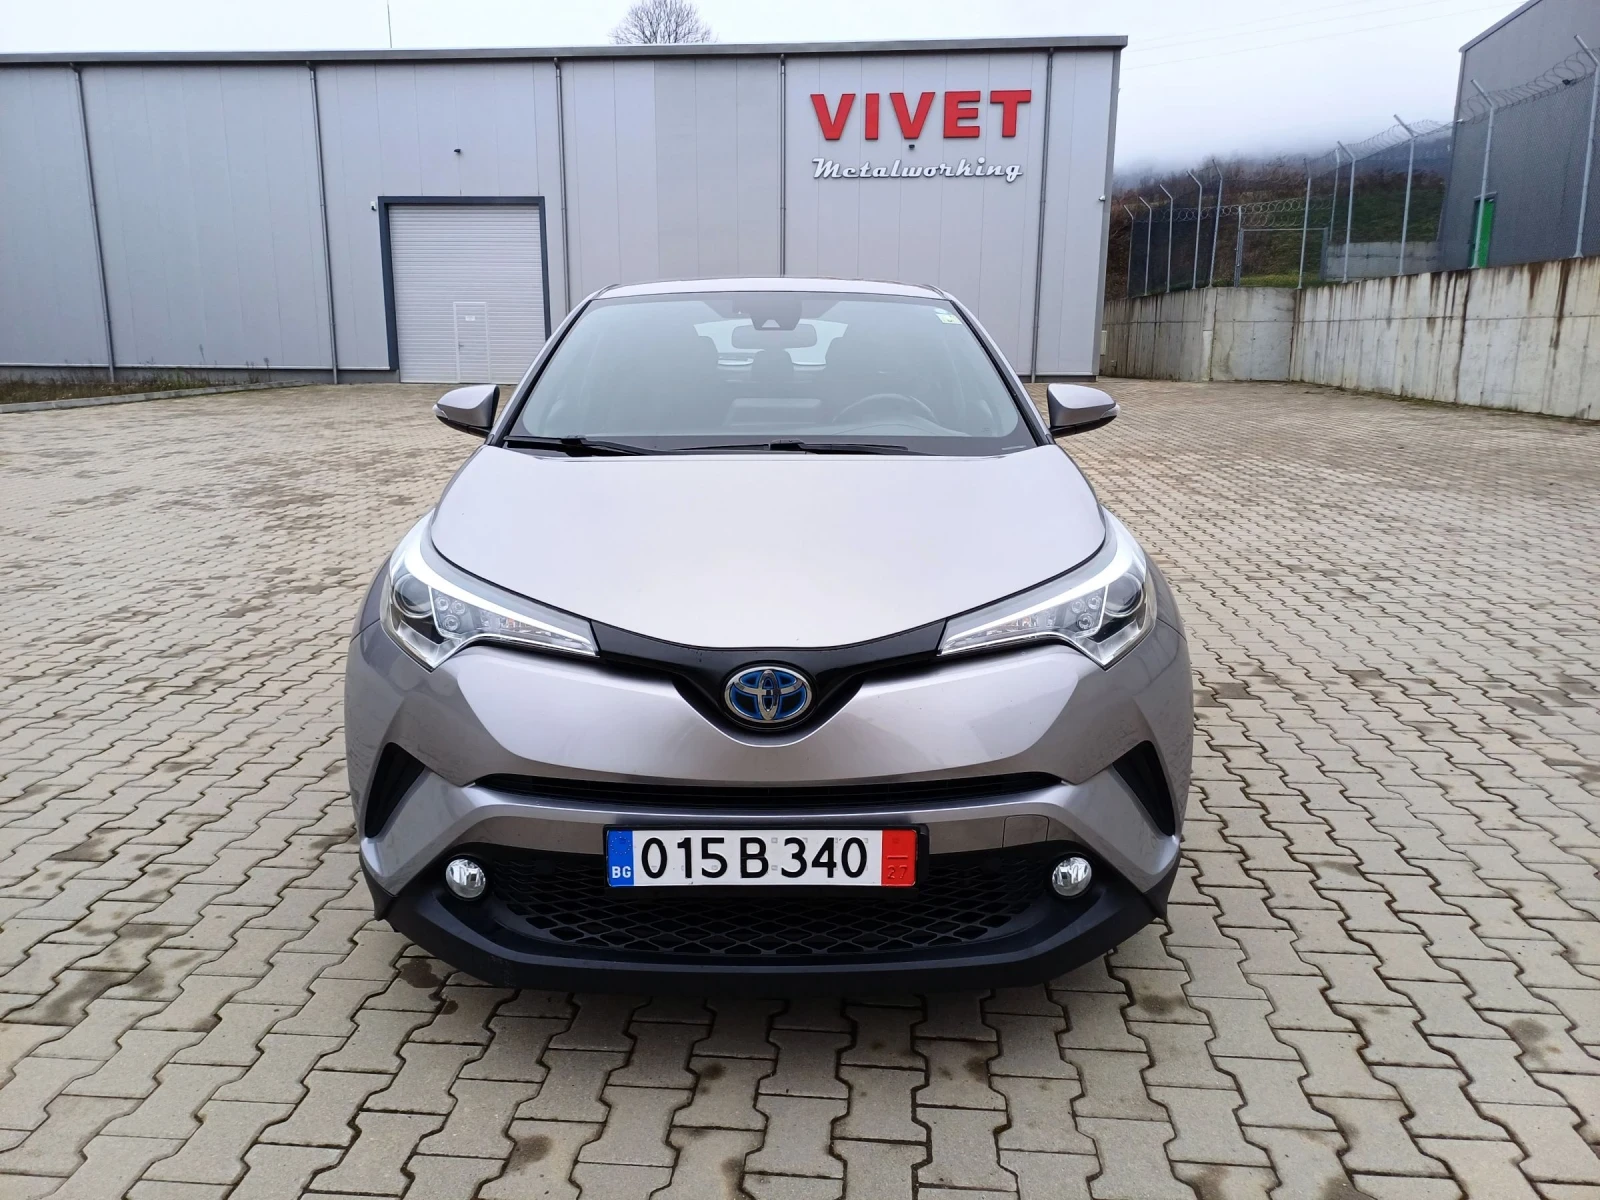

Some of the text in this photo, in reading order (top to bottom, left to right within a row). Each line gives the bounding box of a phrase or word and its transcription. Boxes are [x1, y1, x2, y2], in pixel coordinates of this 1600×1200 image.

[810, 89, 1032, 140] VIVET
[812, 156, 1024, 183] Metalworking
[611, 865, 632, 879] BG
[887, 864, 908, 879] 27
